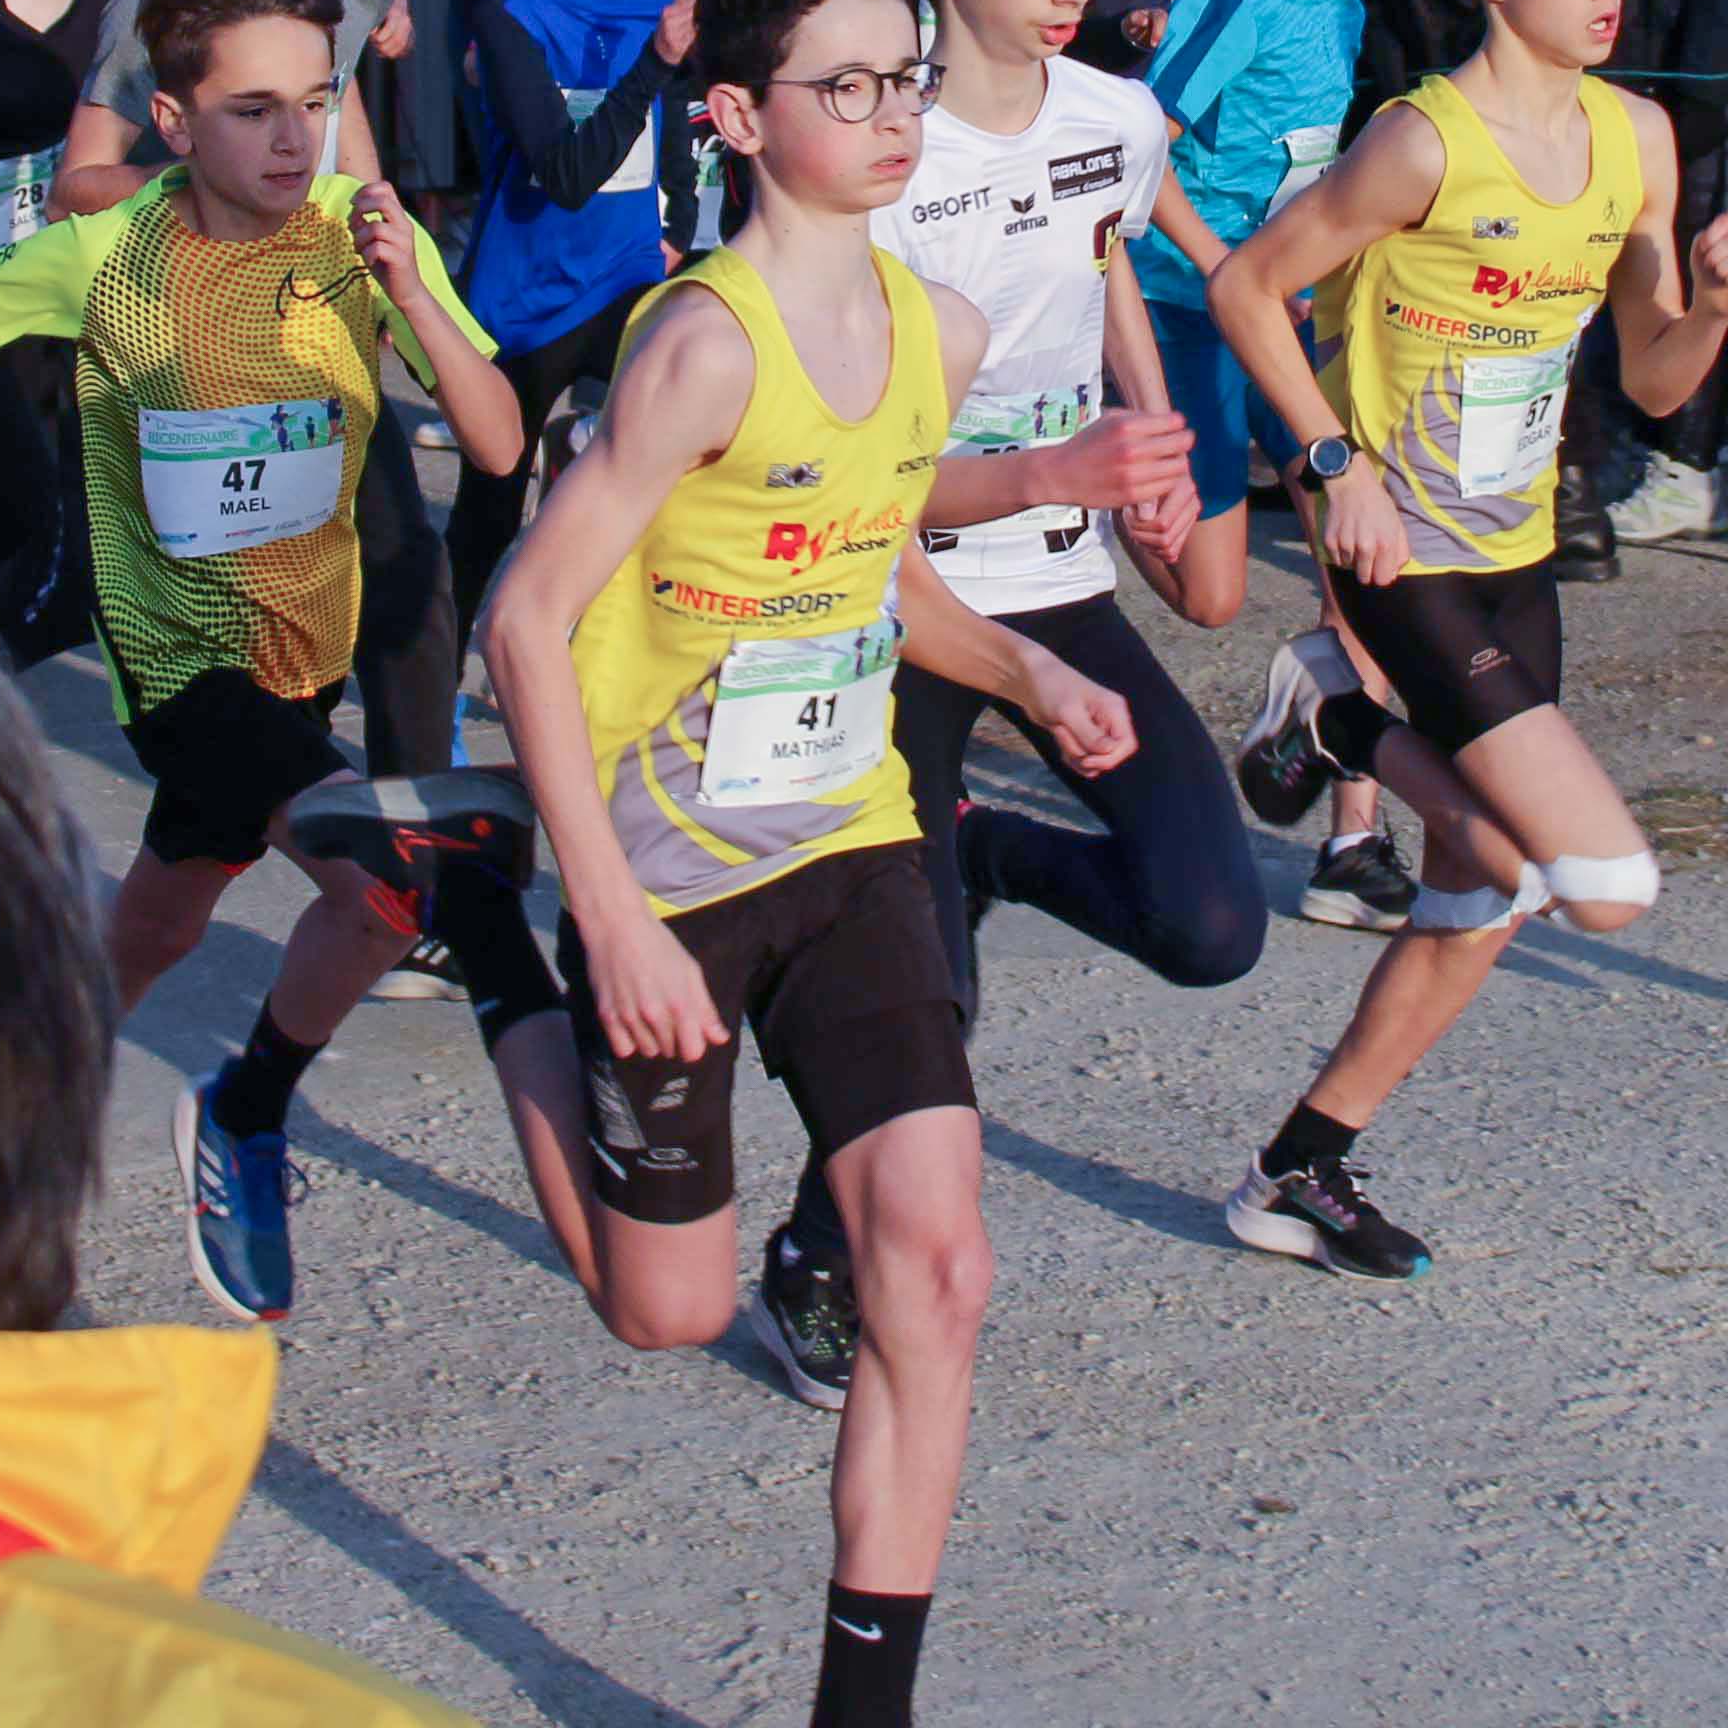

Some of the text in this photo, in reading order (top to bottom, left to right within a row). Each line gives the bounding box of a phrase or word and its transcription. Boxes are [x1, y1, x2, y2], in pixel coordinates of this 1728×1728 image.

[1051, 152, 1115, 181] ABALONE
[13, 183, 44, 210] 28
[1004, 215, 1049, 236] erima
[1400, 306, 1541, 347] INTERSPORT
[222, 459, 267, 493] 47
[219, 496, 272, 516] MAEL
[675, 581, 849, 618] INTERSPORT
[797, 692, 839, 732] 41
[770, 730, 847, 760] MATHIAS
